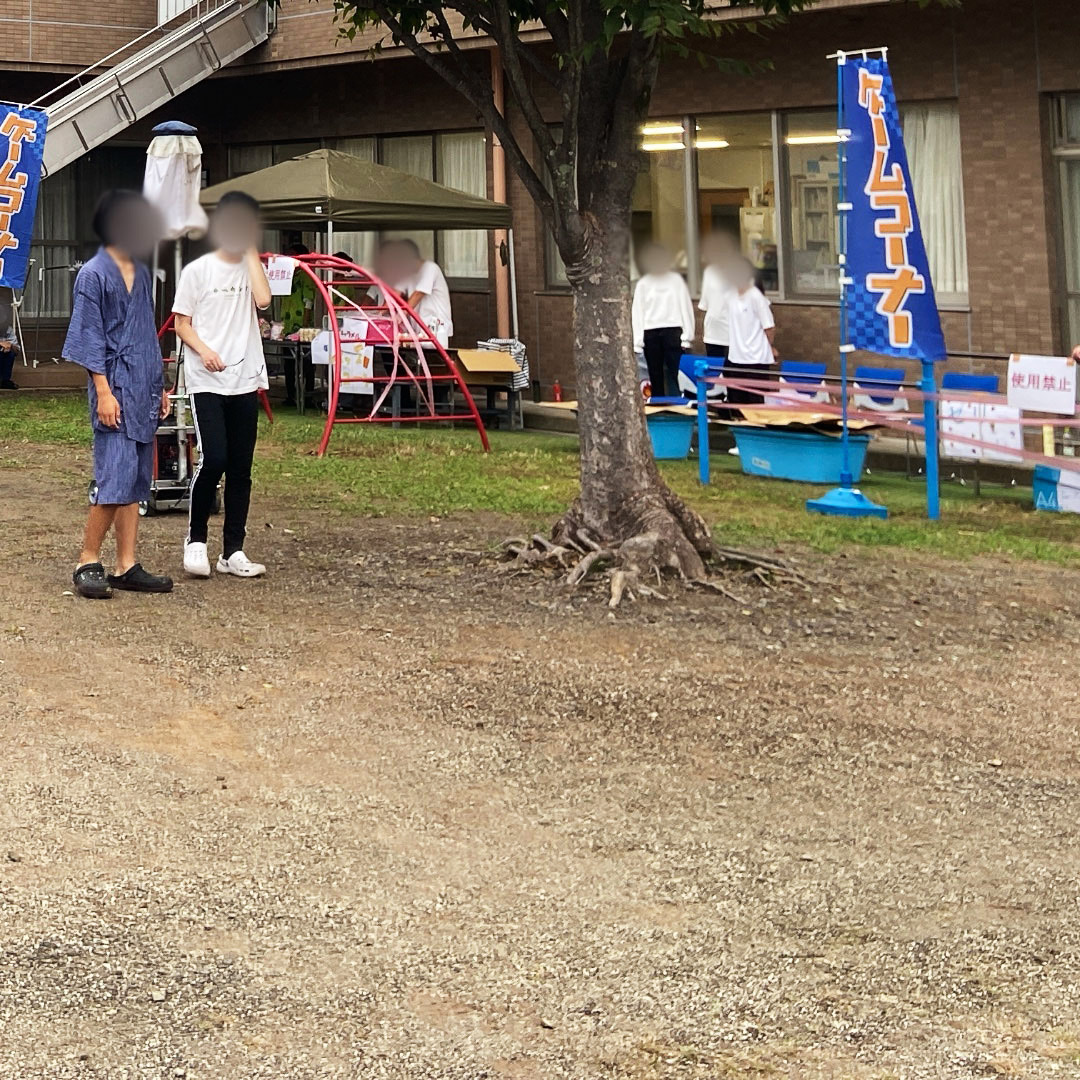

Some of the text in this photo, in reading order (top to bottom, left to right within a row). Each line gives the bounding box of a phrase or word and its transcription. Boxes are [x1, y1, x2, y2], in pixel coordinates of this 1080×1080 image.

[858, 68, 925, 348] ゲームコーナー
[1011, 372, 1071, 393] 使用禁止
